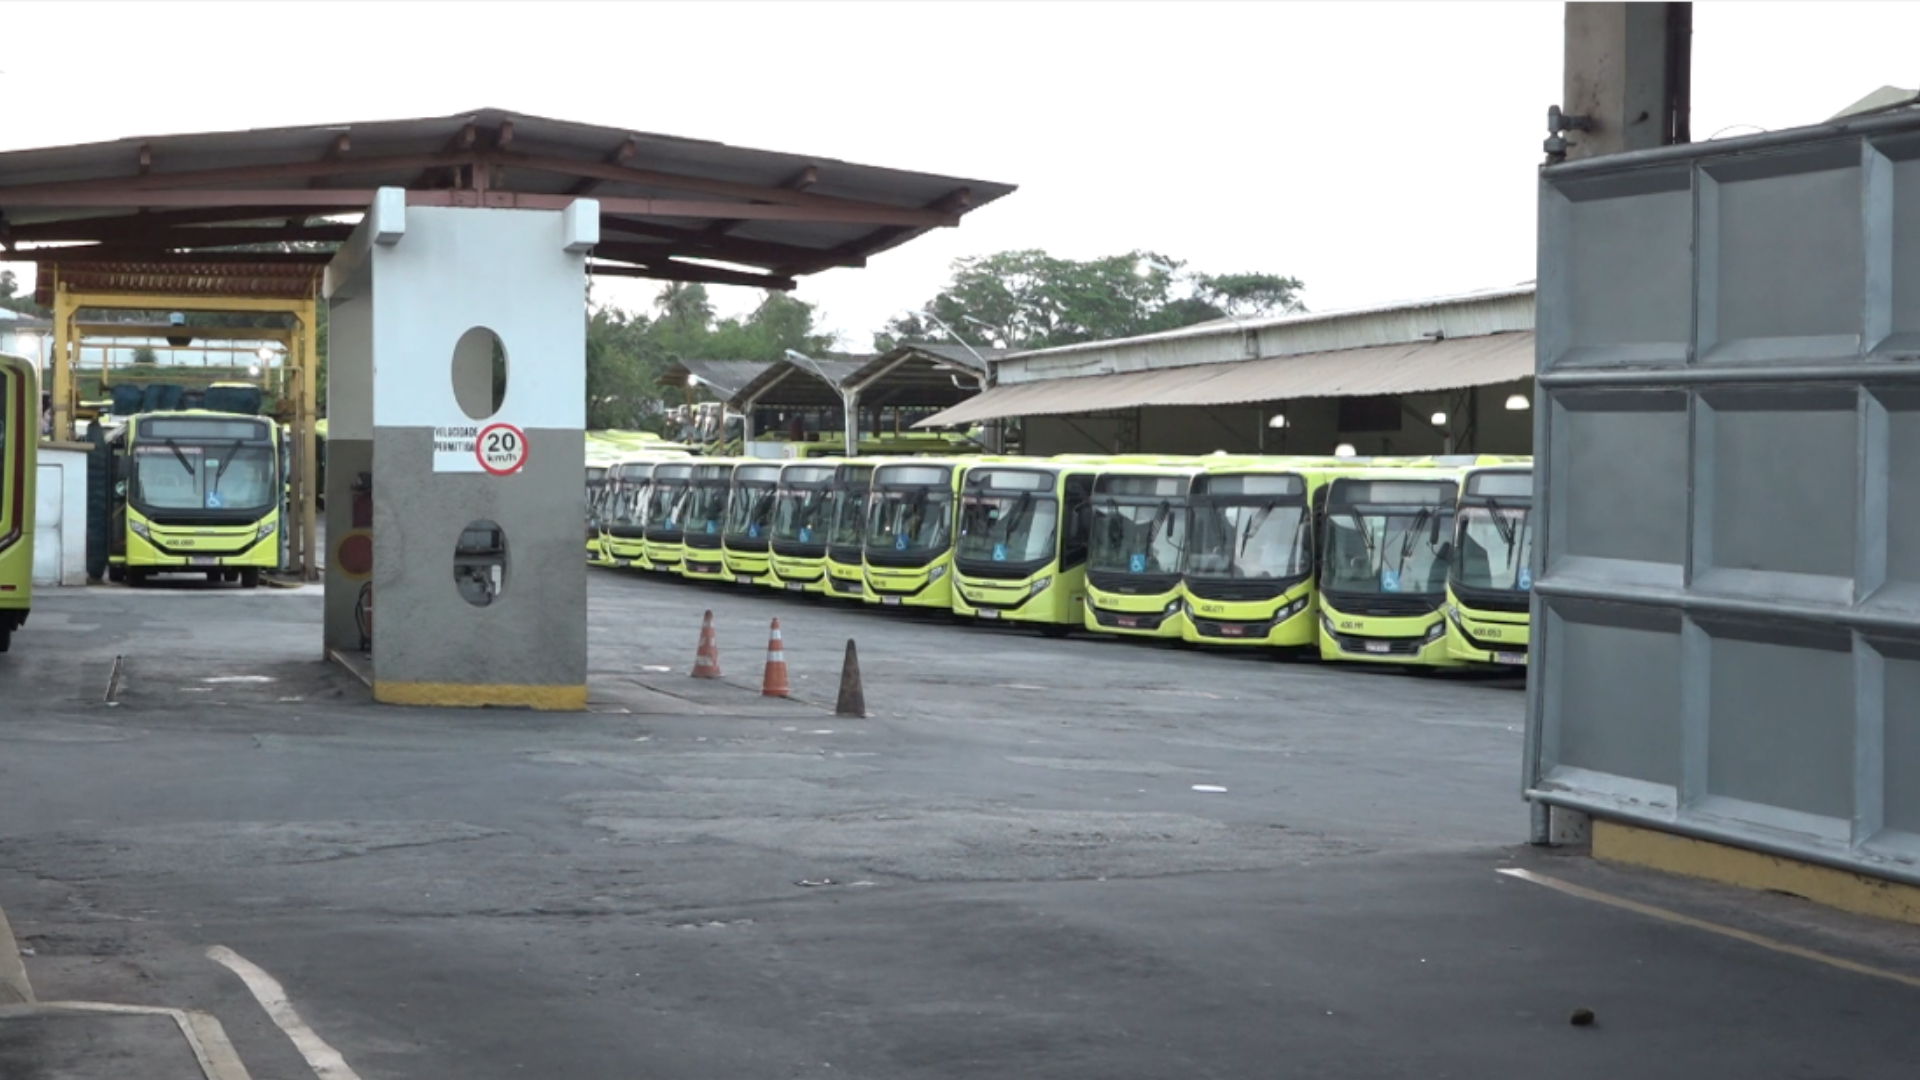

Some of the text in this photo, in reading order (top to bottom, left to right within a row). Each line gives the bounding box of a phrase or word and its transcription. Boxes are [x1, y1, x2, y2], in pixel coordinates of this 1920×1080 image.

[435, 426, 478, 437] VELOCIDADE
[487, 432, 516, 452] 20
[487, 453, 517, 462] km/h
